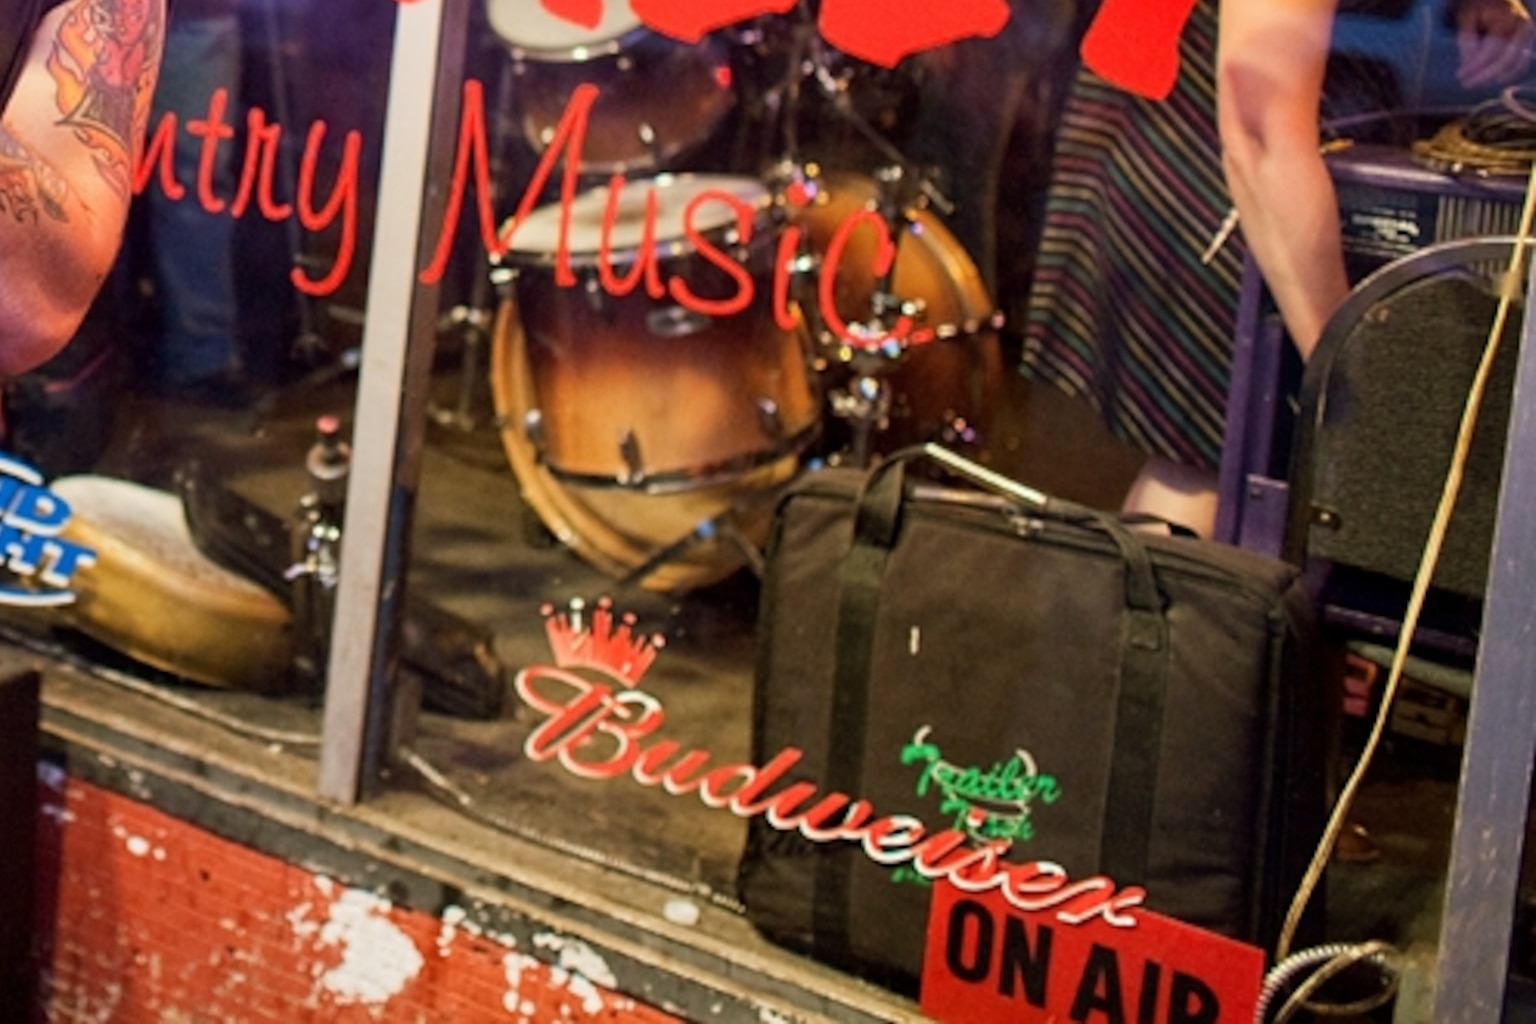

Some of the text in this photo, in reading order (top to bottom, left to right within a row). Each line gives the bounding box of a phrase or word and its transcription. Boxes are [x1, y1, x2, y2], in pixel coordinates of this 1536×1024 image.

[131, 79, 936, 347] ntry Music
[515, 664, 1146, 927] Budweiser
[945, 898, 1054, 1010] ON
